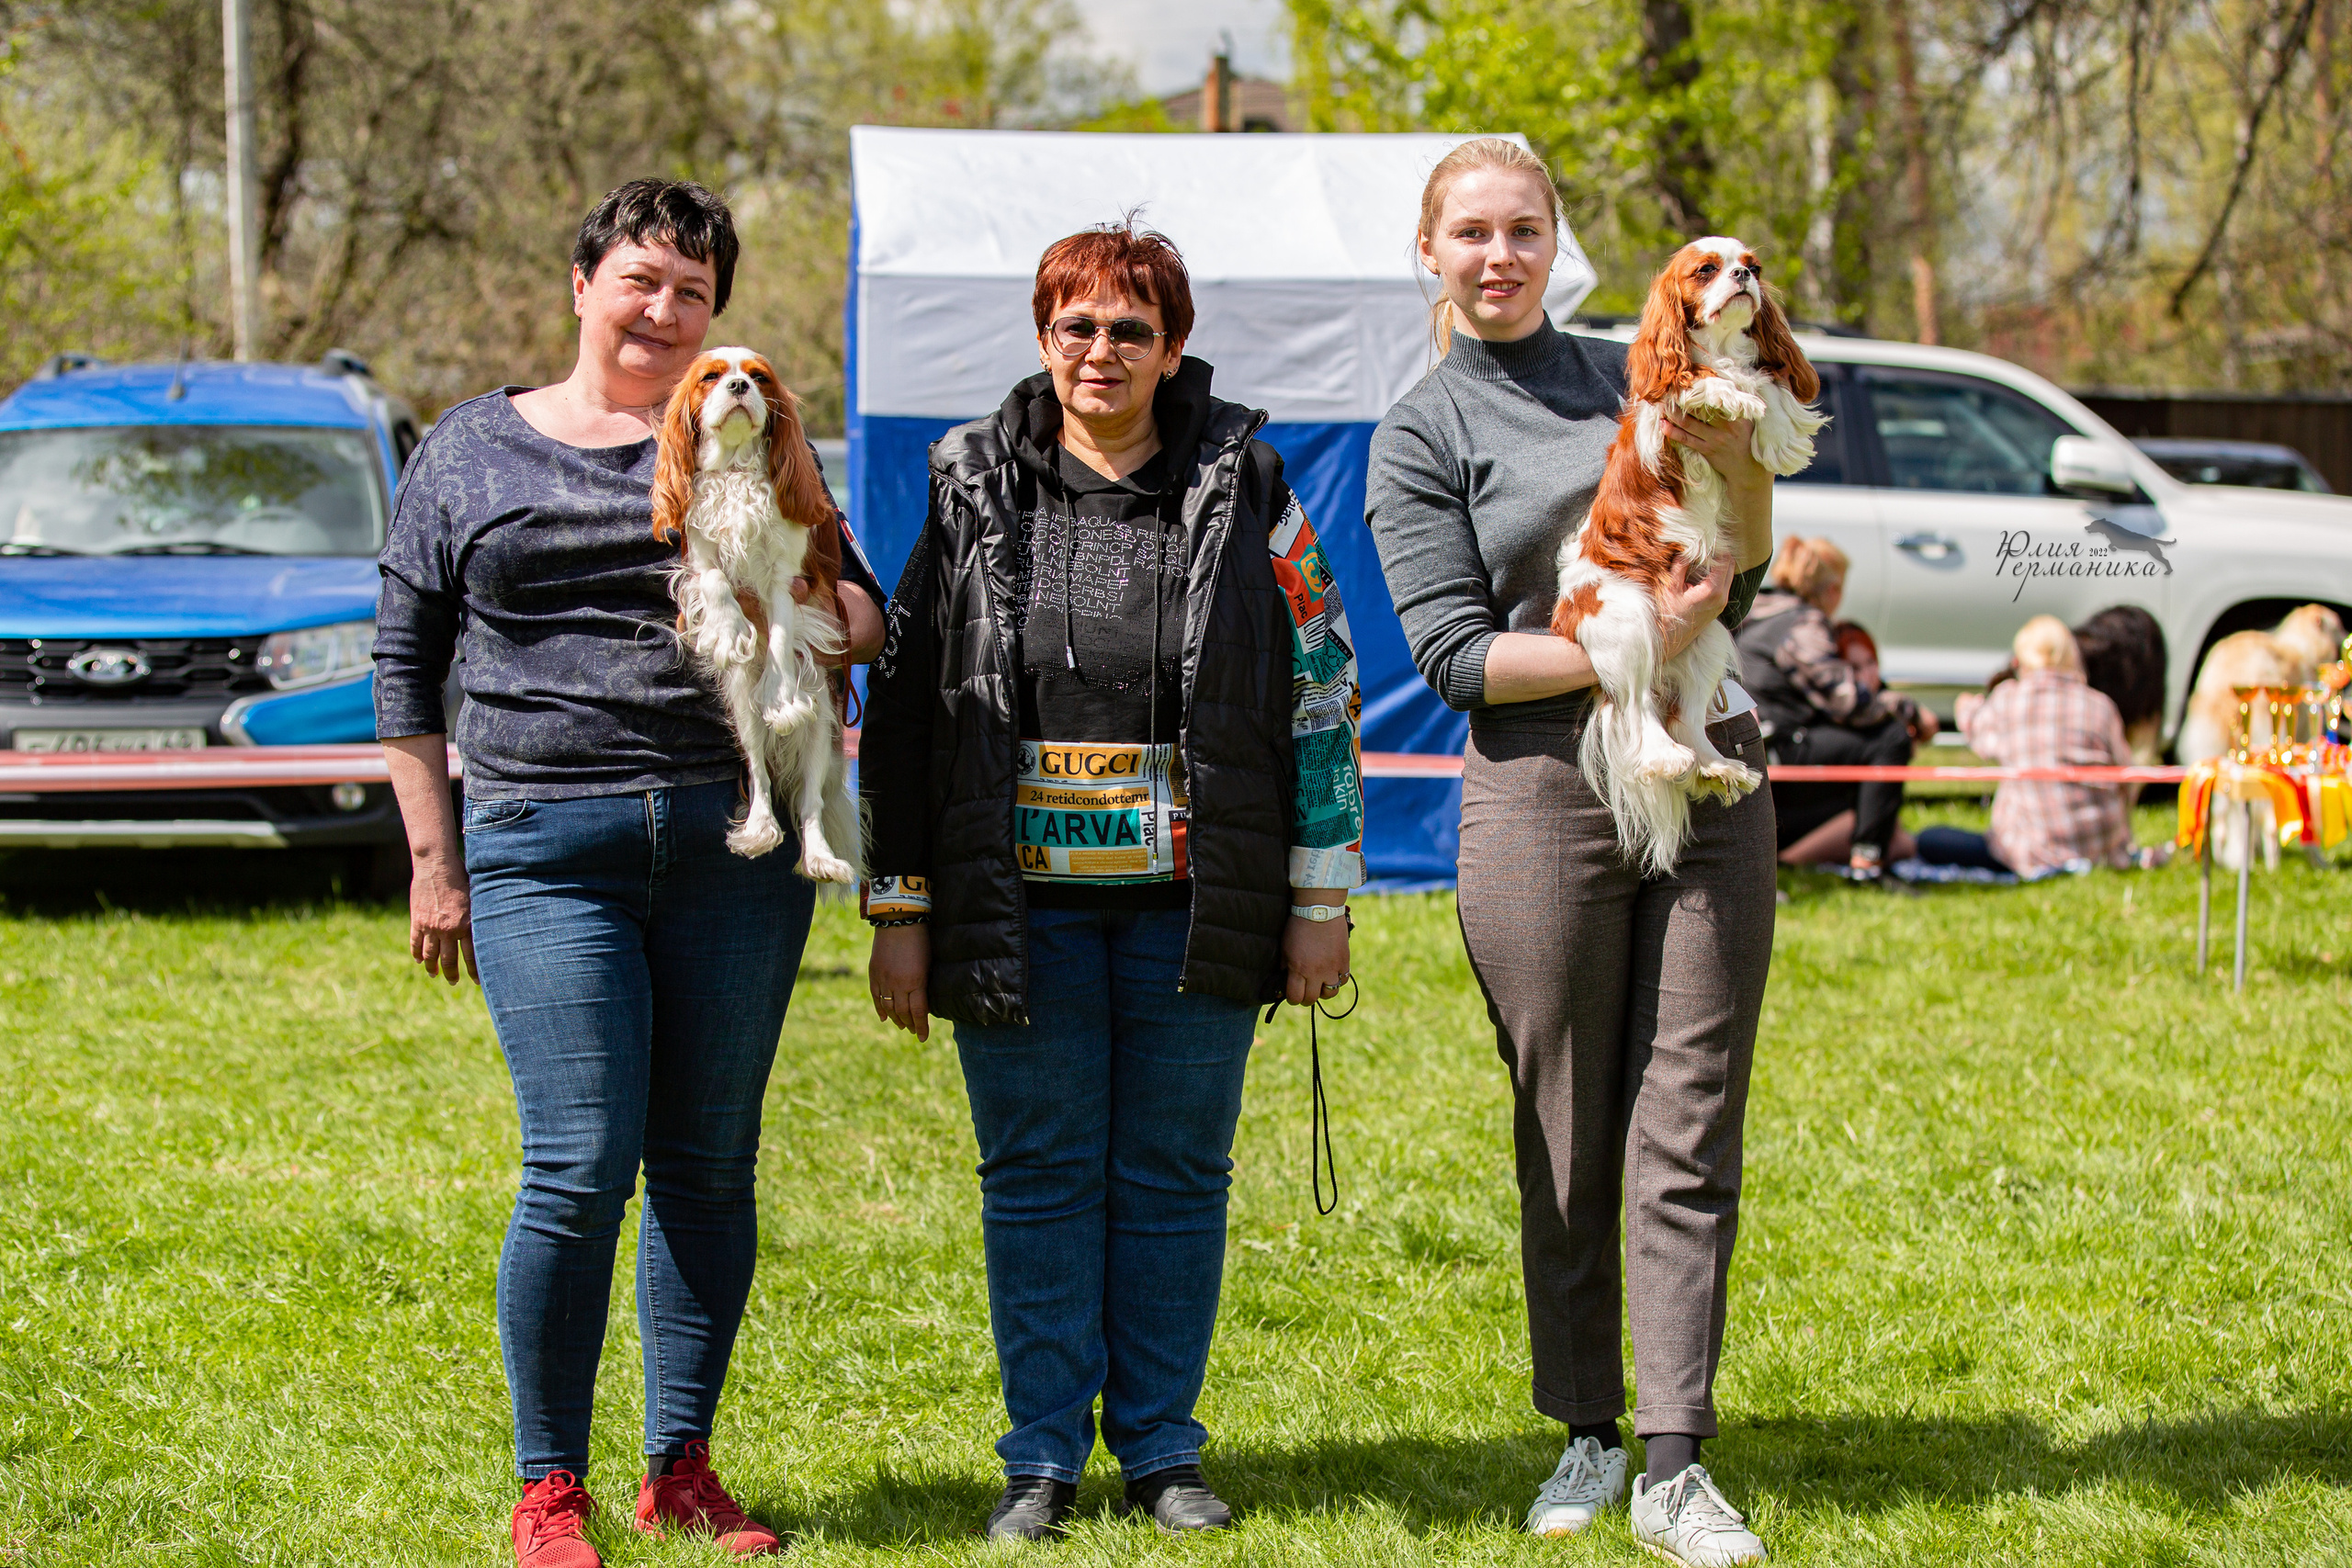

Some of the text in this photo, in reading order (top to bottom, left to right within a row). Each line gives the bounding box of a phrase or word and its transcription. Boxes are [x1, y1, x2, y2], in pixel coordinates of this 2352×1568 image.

[1294, 592, 1308, 619] Plac
[1030, 791, 1044, 802] 24
[1022, 845, 1048, 869] CA
